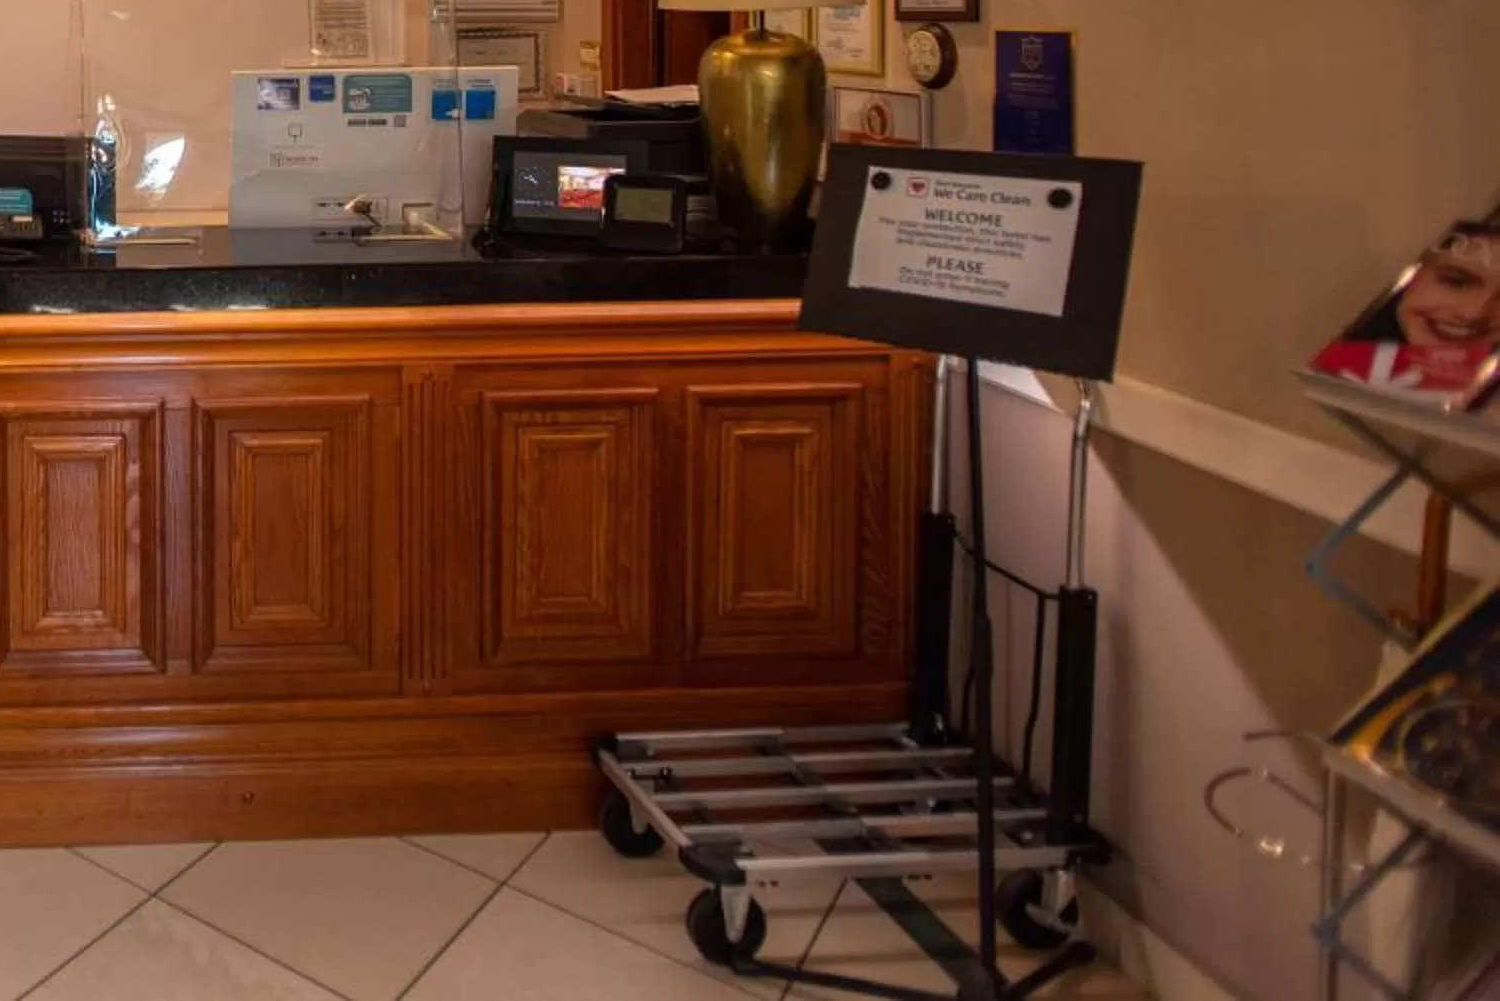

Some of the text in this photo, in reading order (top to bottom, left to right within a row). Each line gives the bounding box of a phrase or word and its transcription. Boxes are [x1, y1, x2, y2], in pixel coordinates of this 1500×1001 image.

[956, 188, 987, 204] Care
[990, 191, 1031, 208] Clean
[924, 206, 1003, 228] WELCOME
[926, 254, 985, 275] PLEASE
